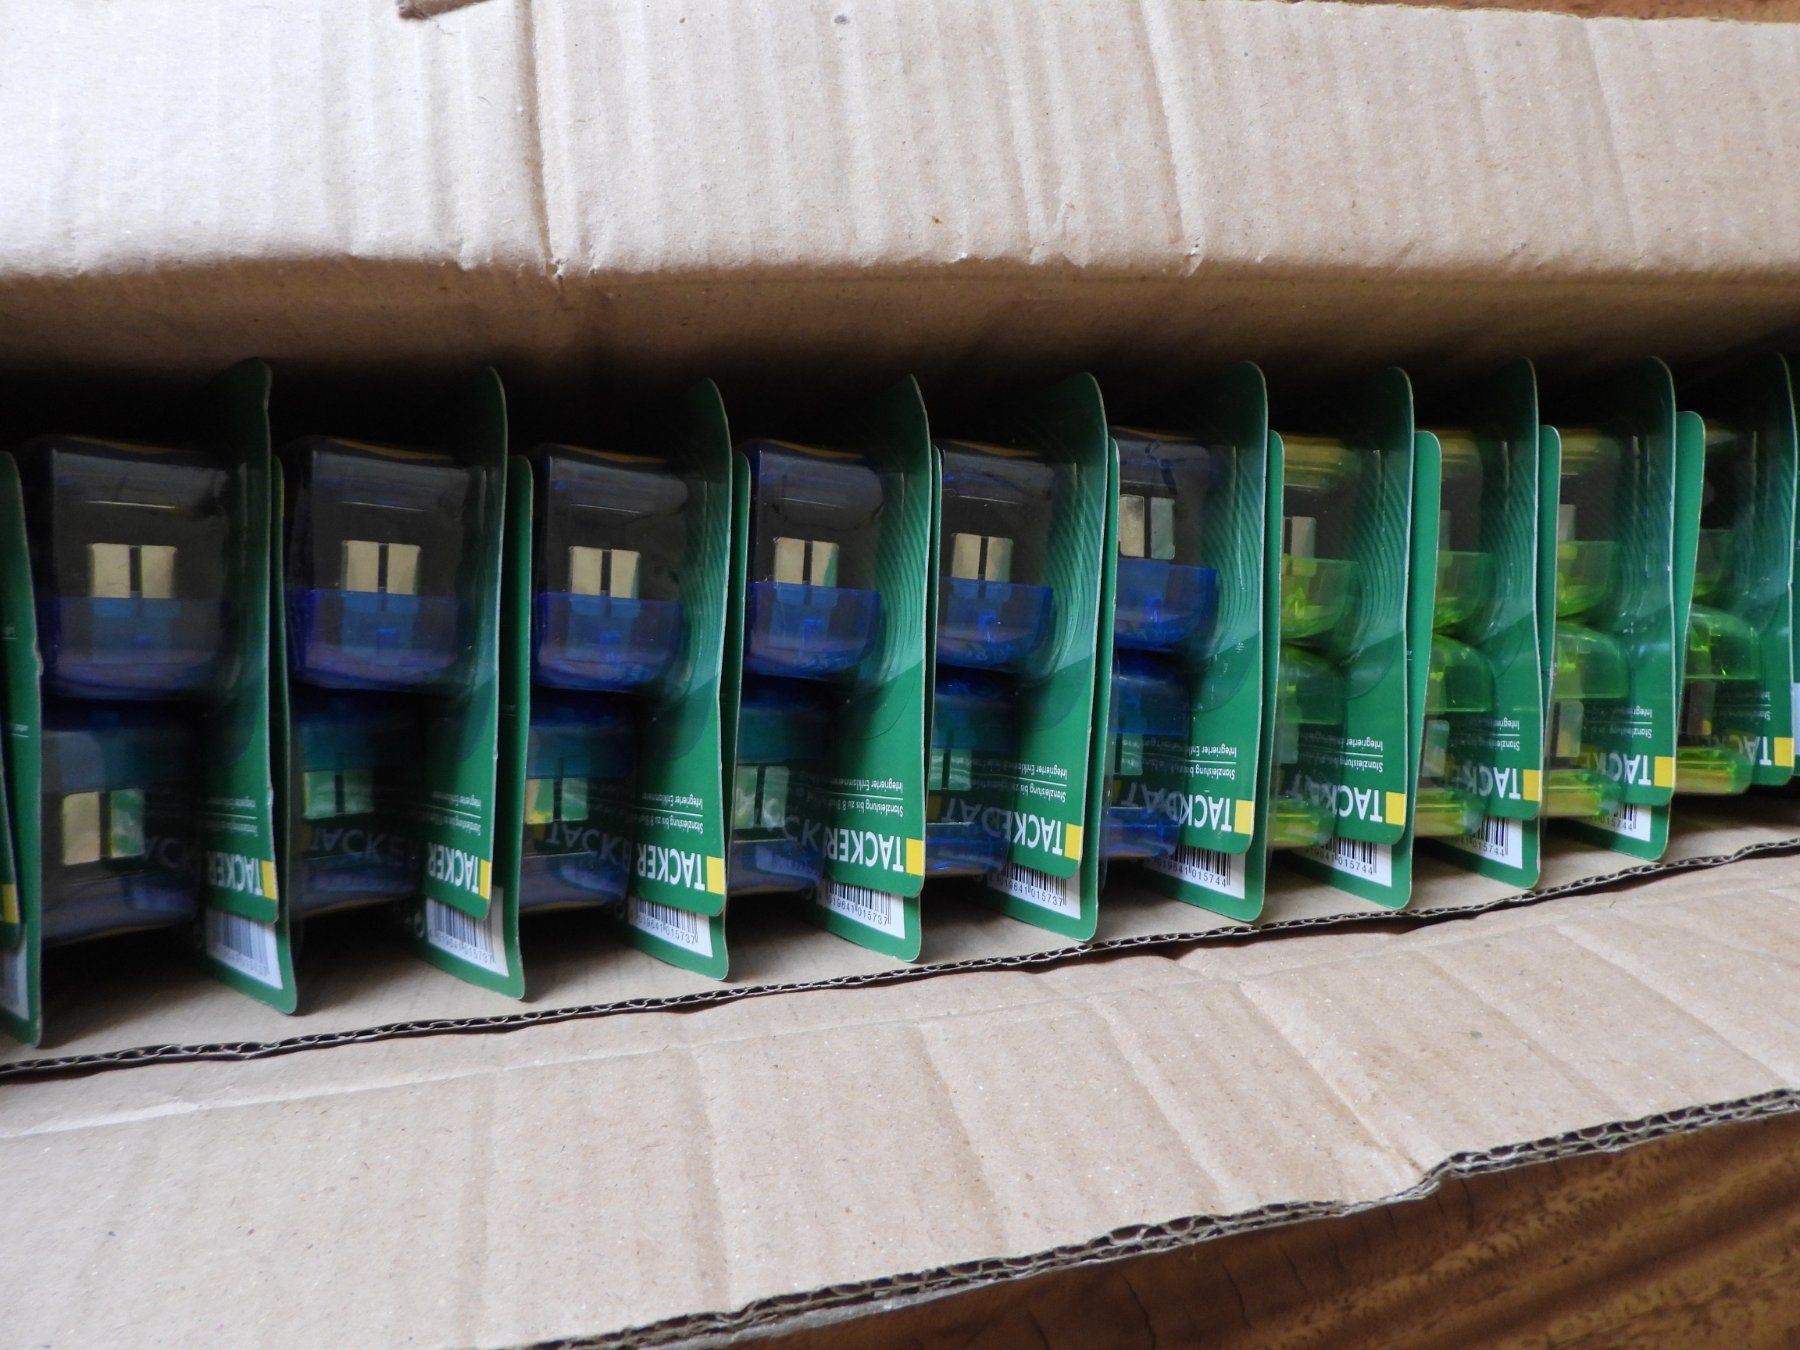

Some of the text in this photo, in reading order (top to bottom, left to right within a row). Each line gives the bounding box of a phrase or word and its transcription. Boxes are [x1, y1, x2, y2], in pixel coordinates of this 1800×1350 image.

[1201, 743, 1238, 759] Integrierter
[1345, 736, 1384, 752] Integrierter
[1035, 764, 1068, 781] Integrierter
[1194, 764, 1236, 781] Stanzleistung
[870, 778, 904, 794] Integrierter
[1028, 783, 1067, 804] Stanzleistung
[865, 799, 904, 818] Stanzleistung
[824, 826, 905, 873] TACKER
[207, 850, 264, 897] TACKER
[428, 842, 479, 895] TACKER
[636, 843, 706, 892] TACKER
